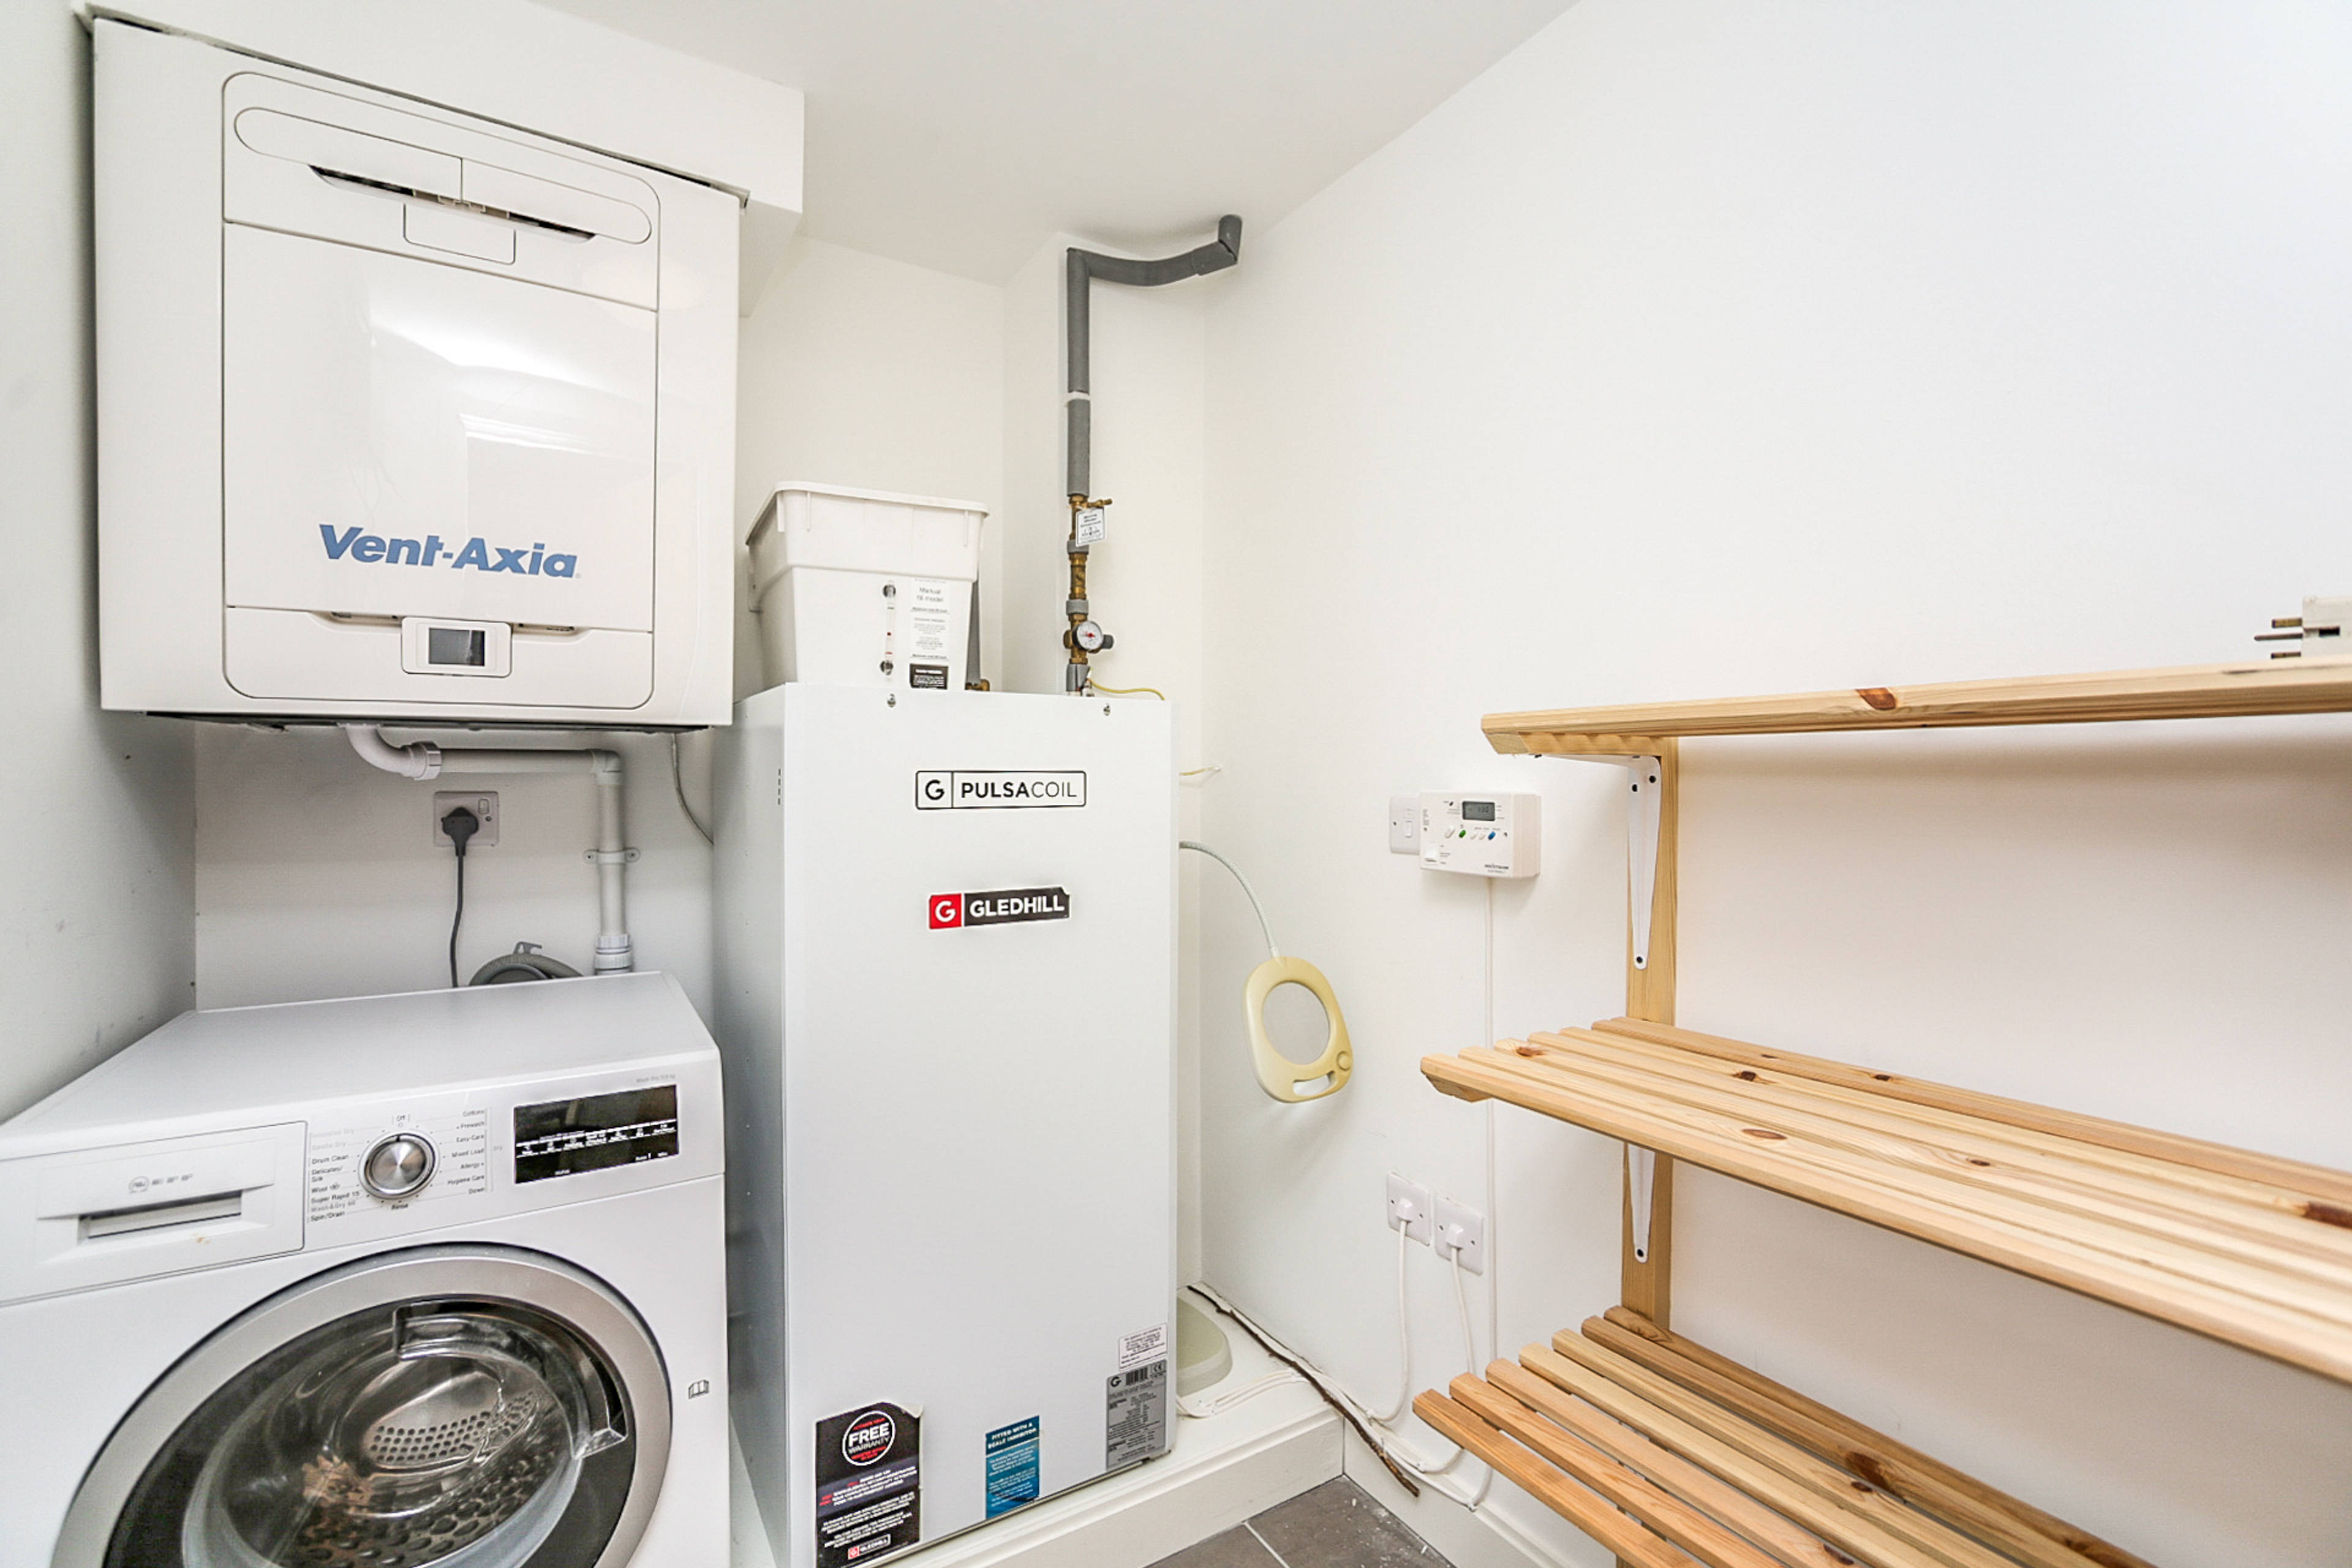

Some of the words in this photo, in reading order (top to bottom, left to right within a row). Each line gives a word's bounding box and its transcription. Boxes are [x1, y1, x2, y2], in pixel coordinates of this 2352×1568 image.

[318, 524, 578, 578] Vent-Axia
[925, 780, 944, 800] G
[962, 782, 1077, 798] PULSACOIL
[935, 901, 956, 922] G
[970, 894, 1065, 917] GLEDHILL
[848, 1422, 889, 1447] FREE
[848, 1436, 890, 1455] WARRANTY
